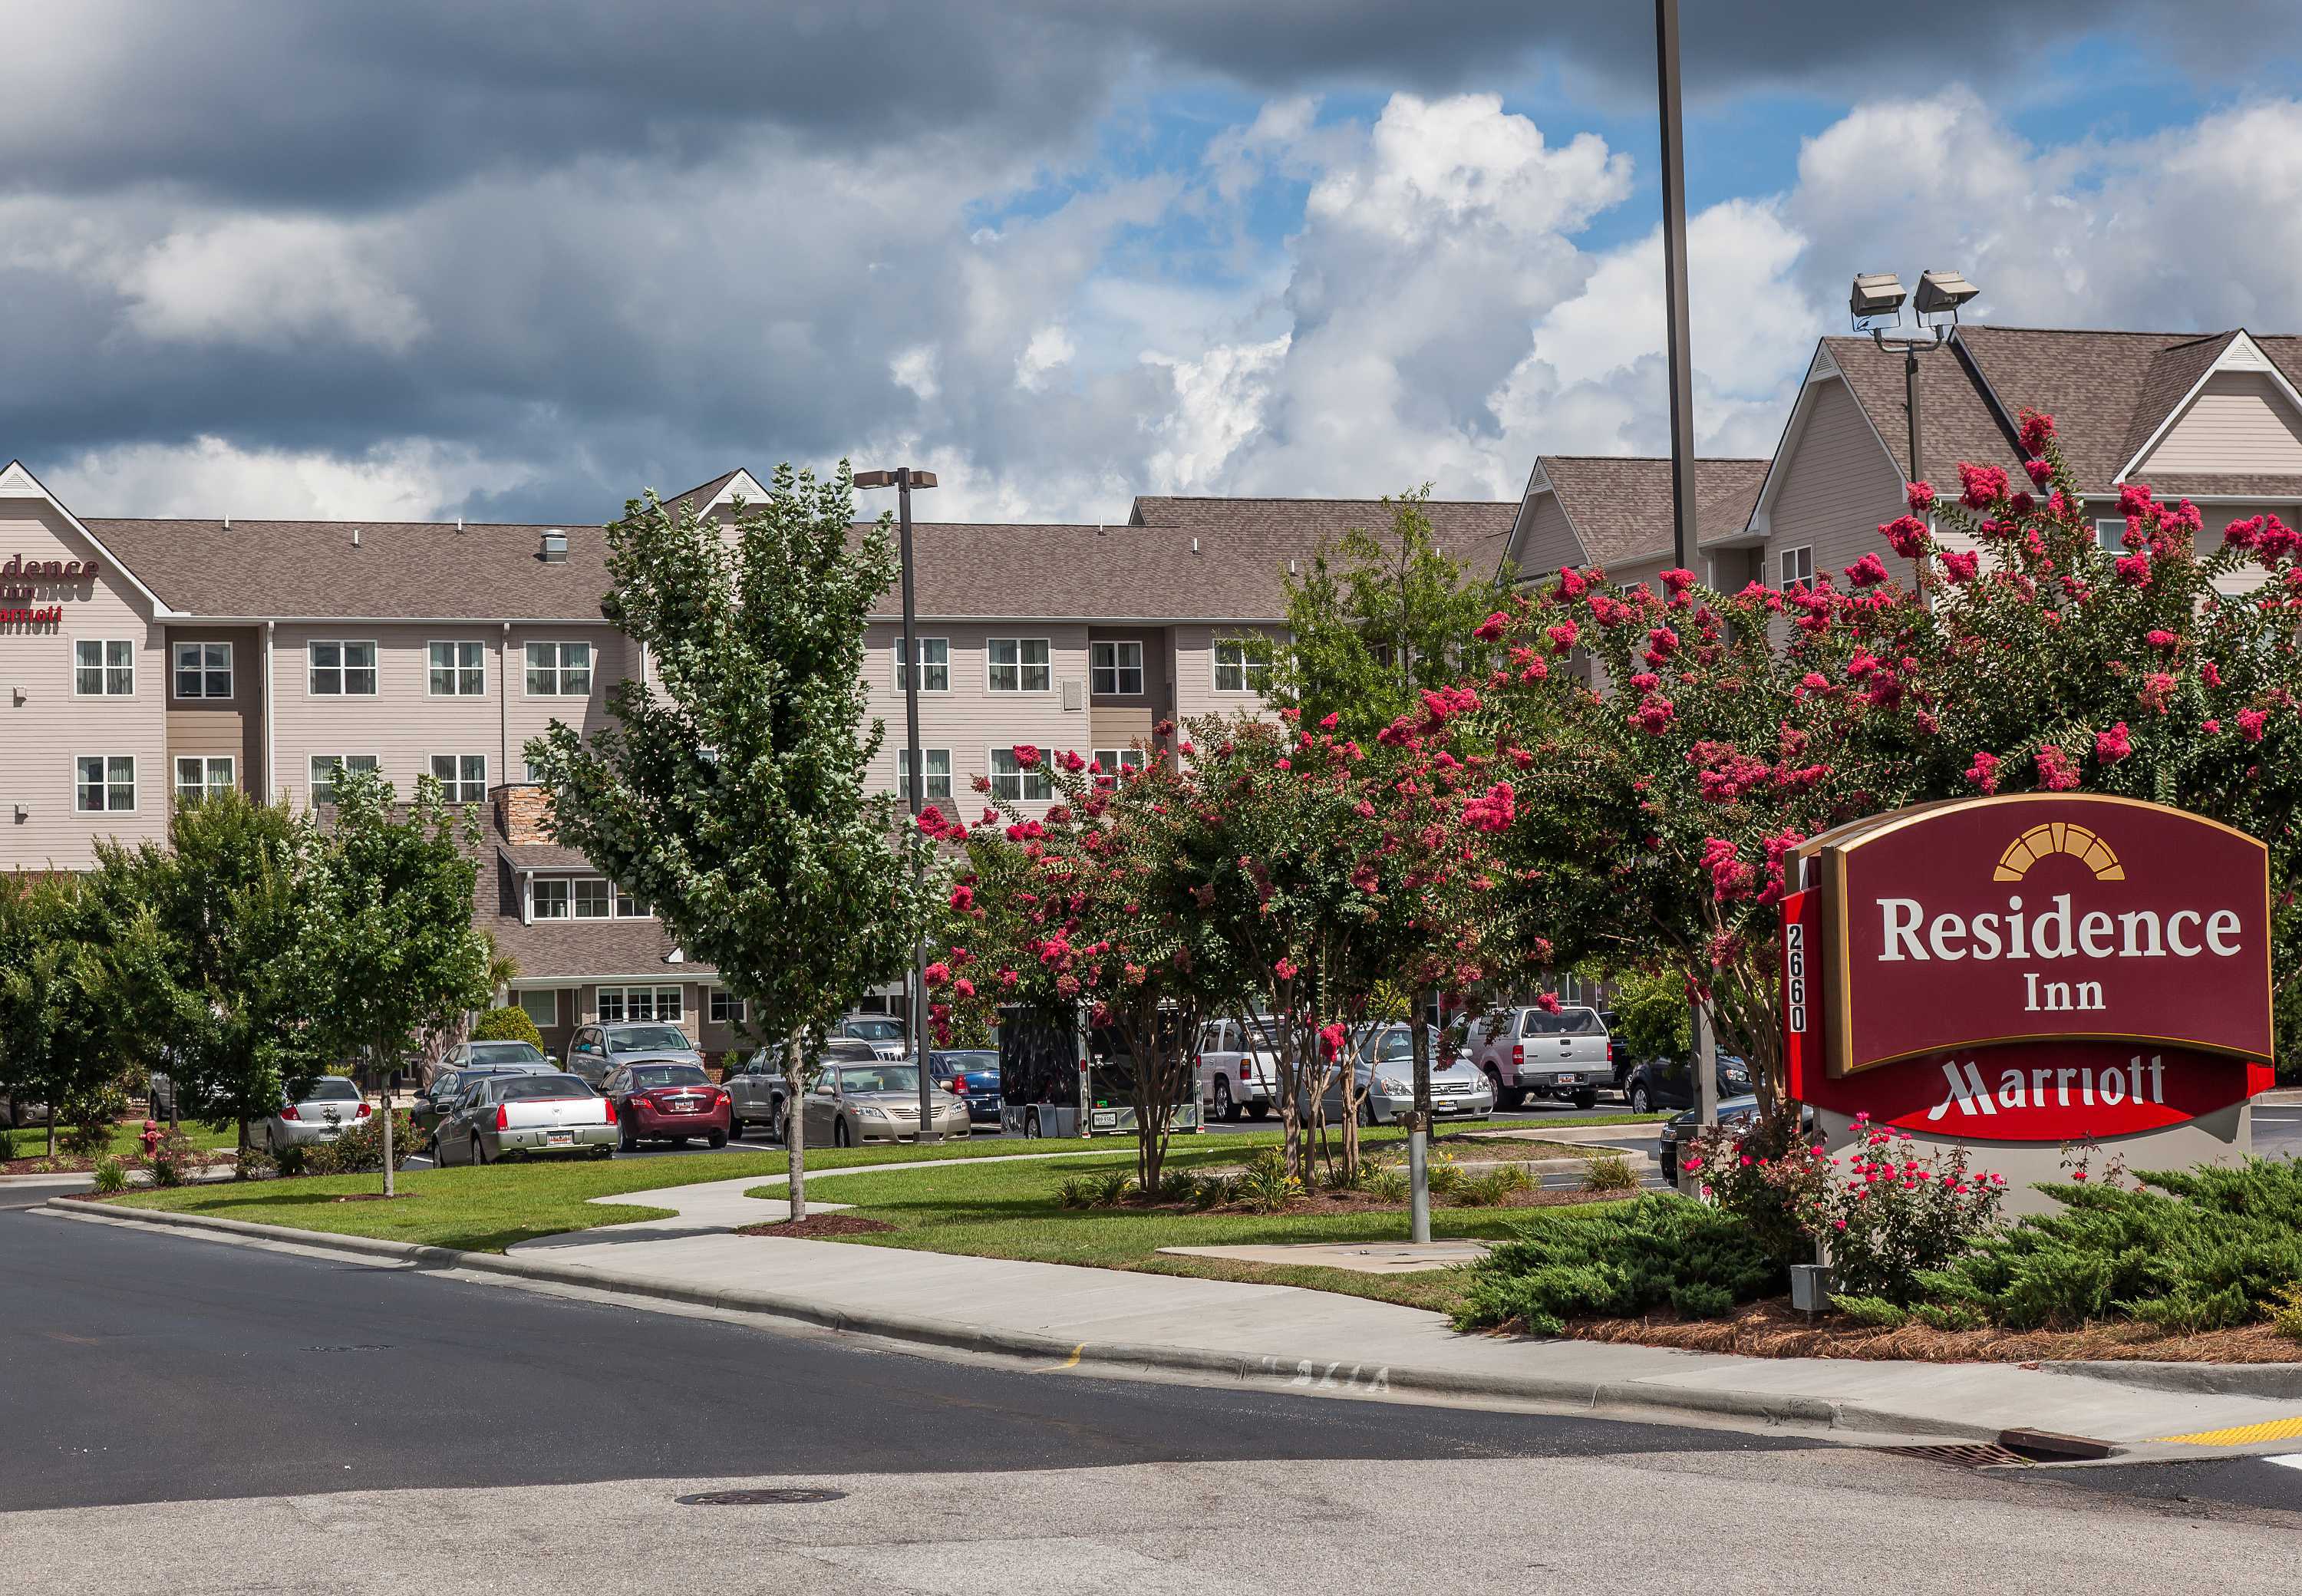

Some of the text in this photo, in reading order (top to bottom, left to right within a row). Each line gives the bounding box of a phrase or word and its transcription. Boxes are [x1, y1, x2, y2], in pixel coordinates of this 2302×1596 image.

[1875, 893, 2242, 961] Residence
[1789, 925, 1804, 1032] 2660
[2023, 973, 2106, 1011] Inn
[1927, 1054, 2165, 1121] Marriott
